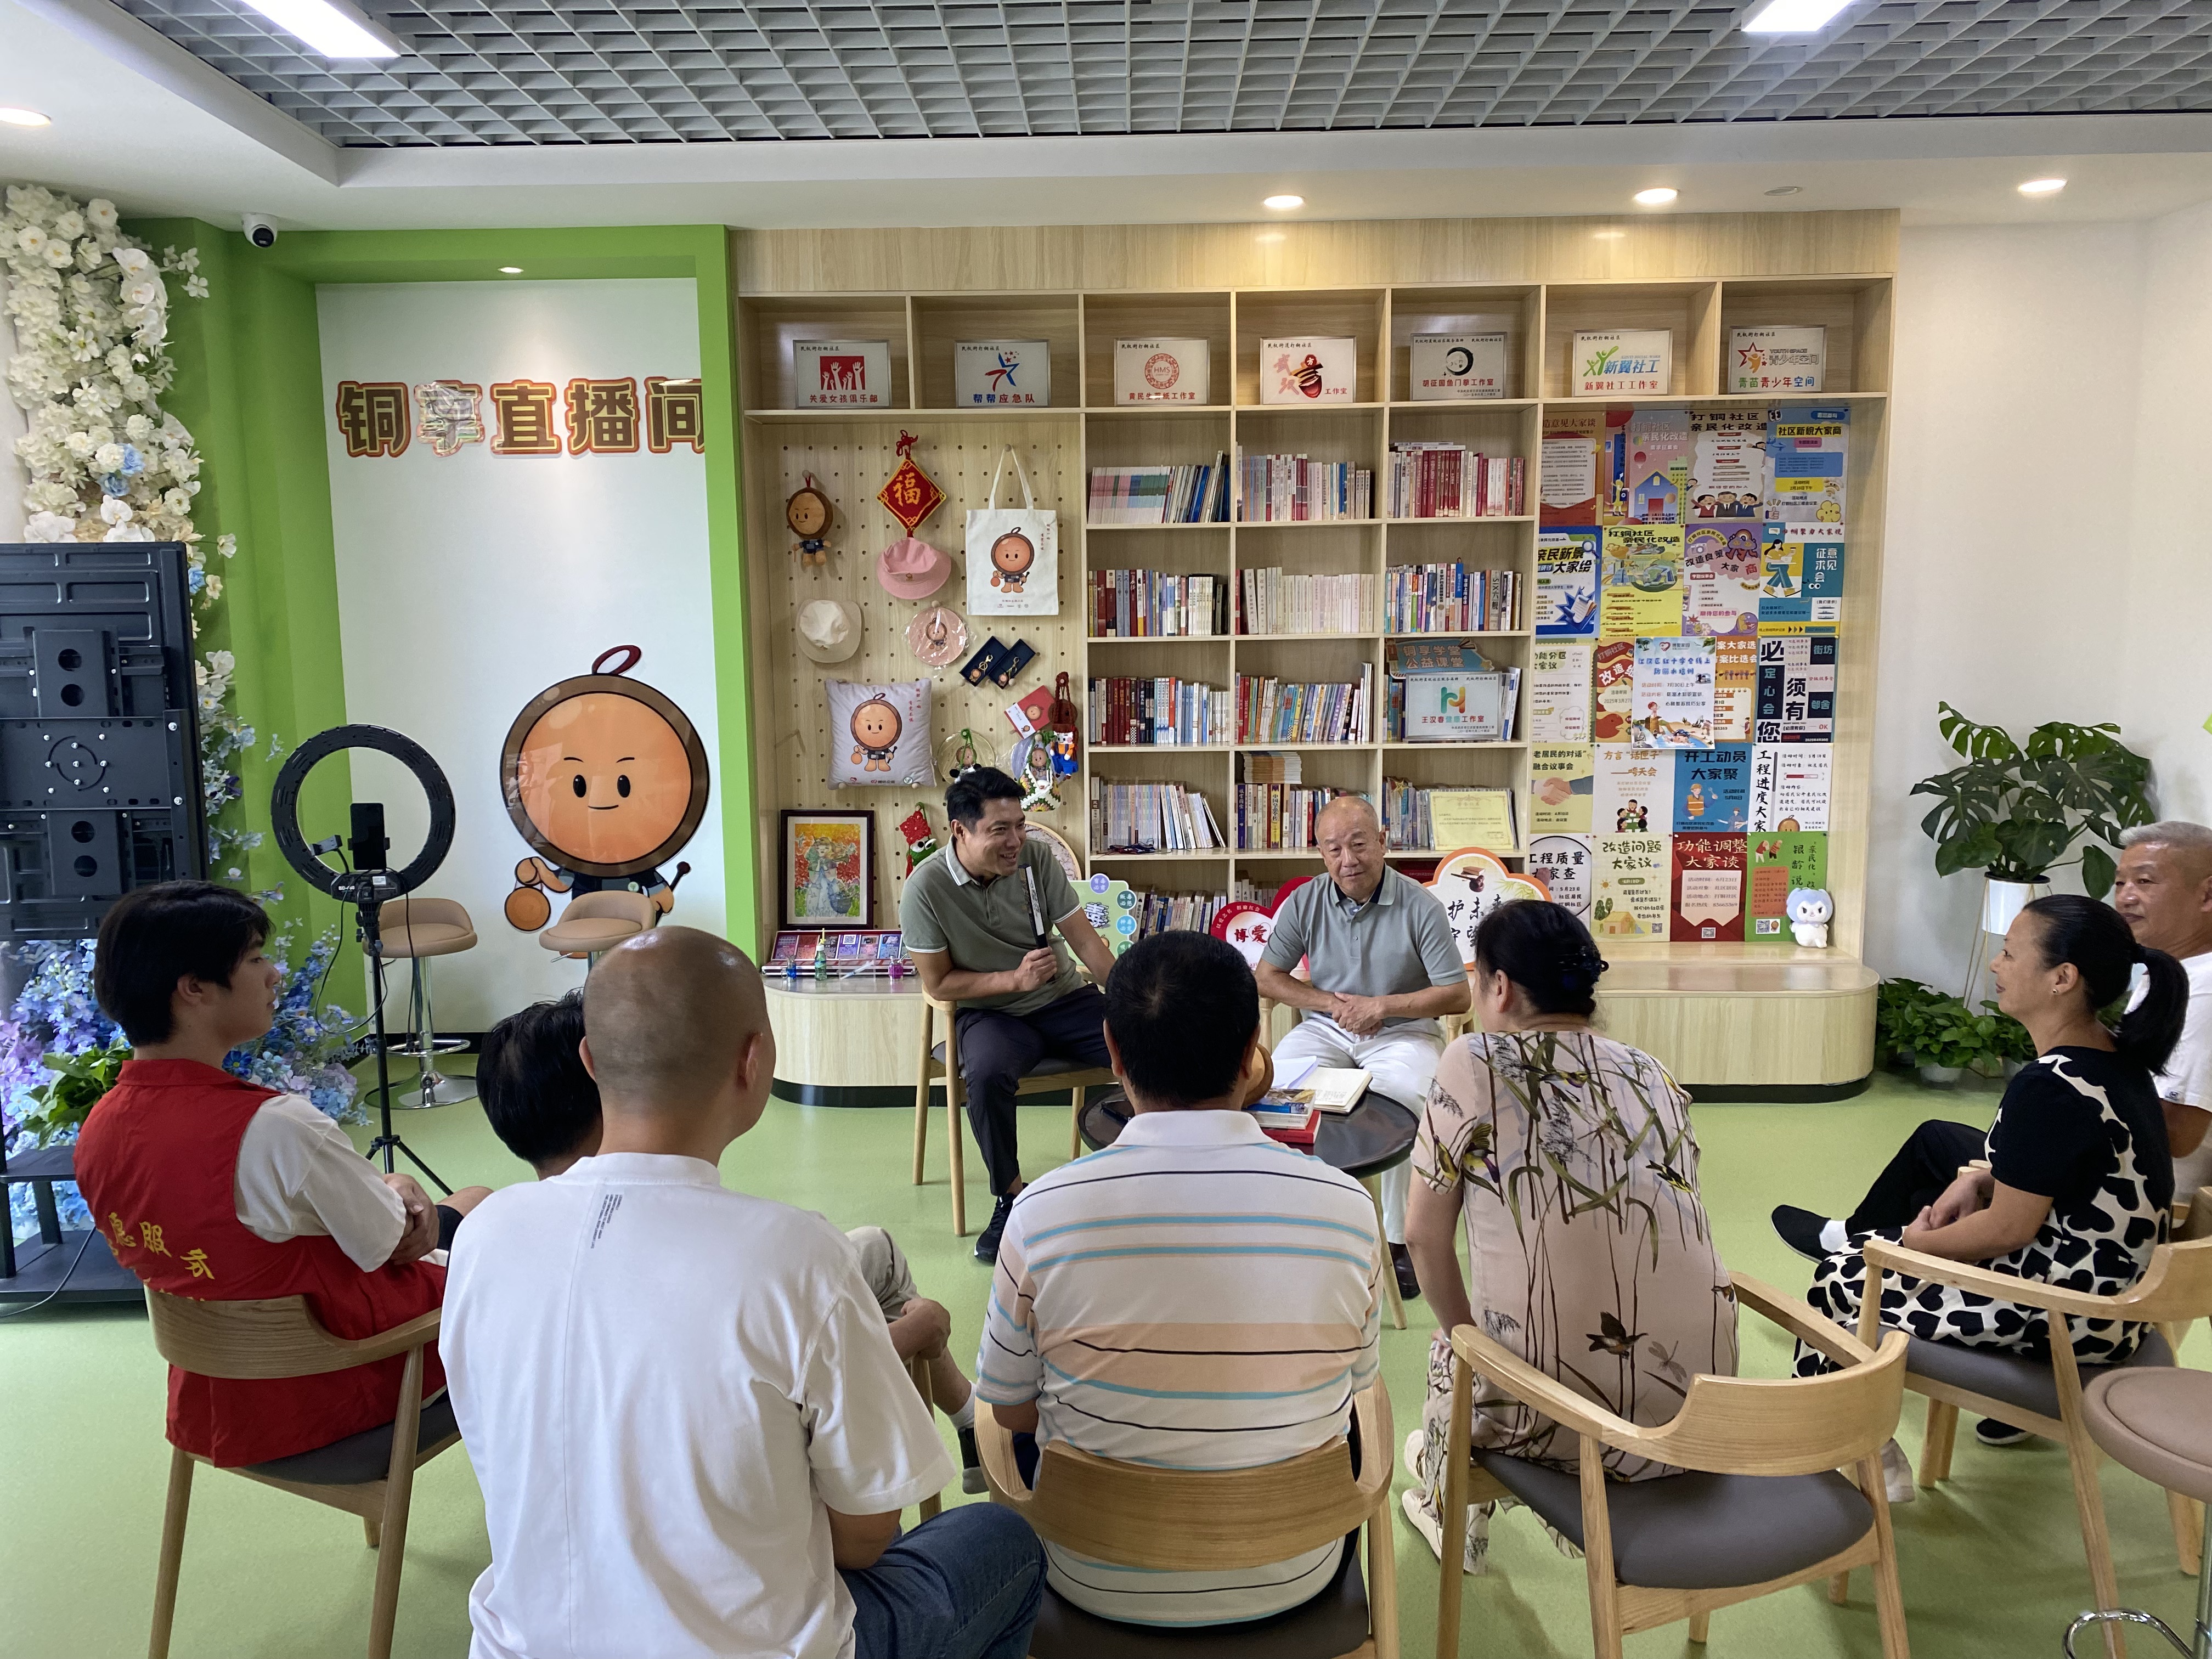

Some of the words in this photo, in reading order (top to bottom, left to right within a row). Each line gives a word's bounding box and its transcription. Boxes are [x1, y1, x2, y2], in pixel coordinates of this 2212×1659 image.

[1769, 354, 1819, 365] 青少年空间
[1604, 359, 1660, 374] 新翼社工
[1585, 381, 1658, 391] 新翼社工工作室
[1739, 376, 1814, 388] 青苗青少年空间
[809, 394, 878, 403] 关爱女孩俱乐部
[973, 393, 1035, 403] 帮帮应急队
[1691, 413, 1759, 421] 打铜社区
[1690, 422, 1767, 431] 亲民化改造
[1641, 432, 1689, 442] 亲民化改造
[893, 472, 921, 506] 福
[1685, 550, 1725, 567] 改造良策
[1553, 560, 1592, 574] 大家绘
[1403, 645, 1462, 657] 铜享学堂
[1761, 640, 1785, 662] 必
[1814, 645, 1833, 655] 街坊
[1406, 657, 1465, 670] 公益课堂
[1638, 657, 1711, 665] 江汉区红十字会线上
[1763, 667, 1777, 715] 定心会
[1811, 700, 1831, 710] 邻舍
[1757, 721, 1781, 743] 您
[1684, 751, 1747, 763] 开工动员
[1533, 763, 1574, 771] 融合议事会
[1691, 768, 1739, 780] 大家聚
[1602, 840, 1662, 854] 改造问题
[1677, 838, 1747, 854] 功能调整
[1612, 856, 1652, 871] 大家议
[1685, 854, 1740, 870] 大家谈
[1791, 845, 1804, 886] 银龄说
[1234, 924, 1268, 944] 博爱
